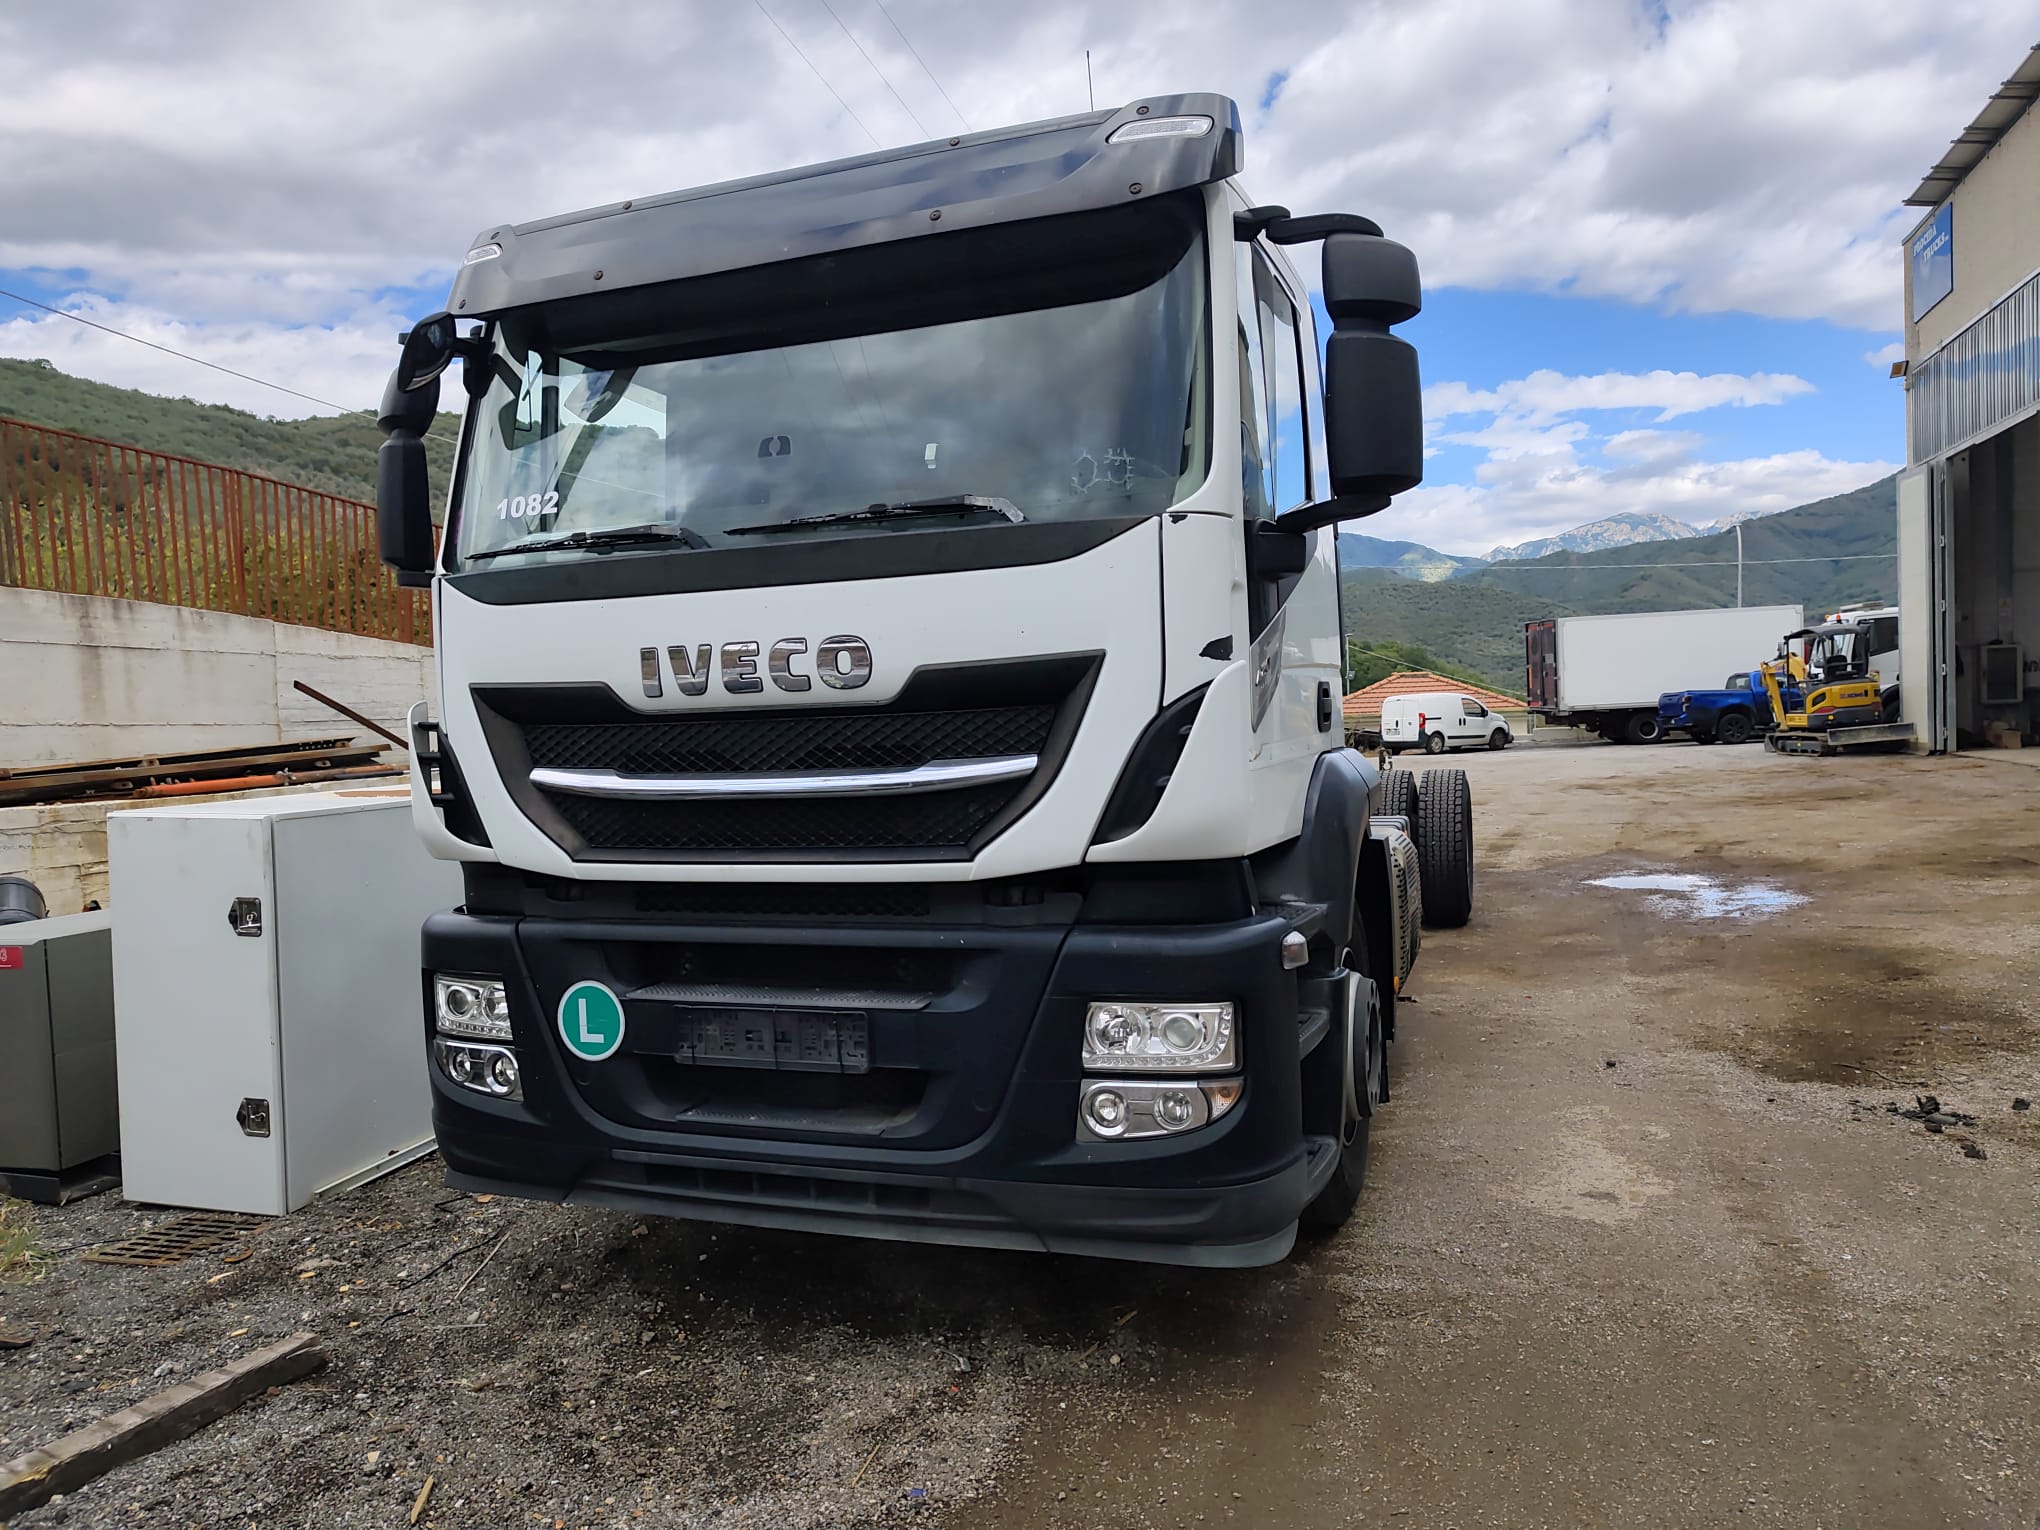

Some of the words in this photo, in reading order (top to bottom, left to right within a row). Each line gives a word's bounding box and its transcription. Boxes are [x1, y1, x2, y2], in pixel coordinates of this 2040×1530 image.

[497, 491, 559, 520] 1082
[640, 634, 873, 698] IVECO
[578, 998, 605, 1044] L
